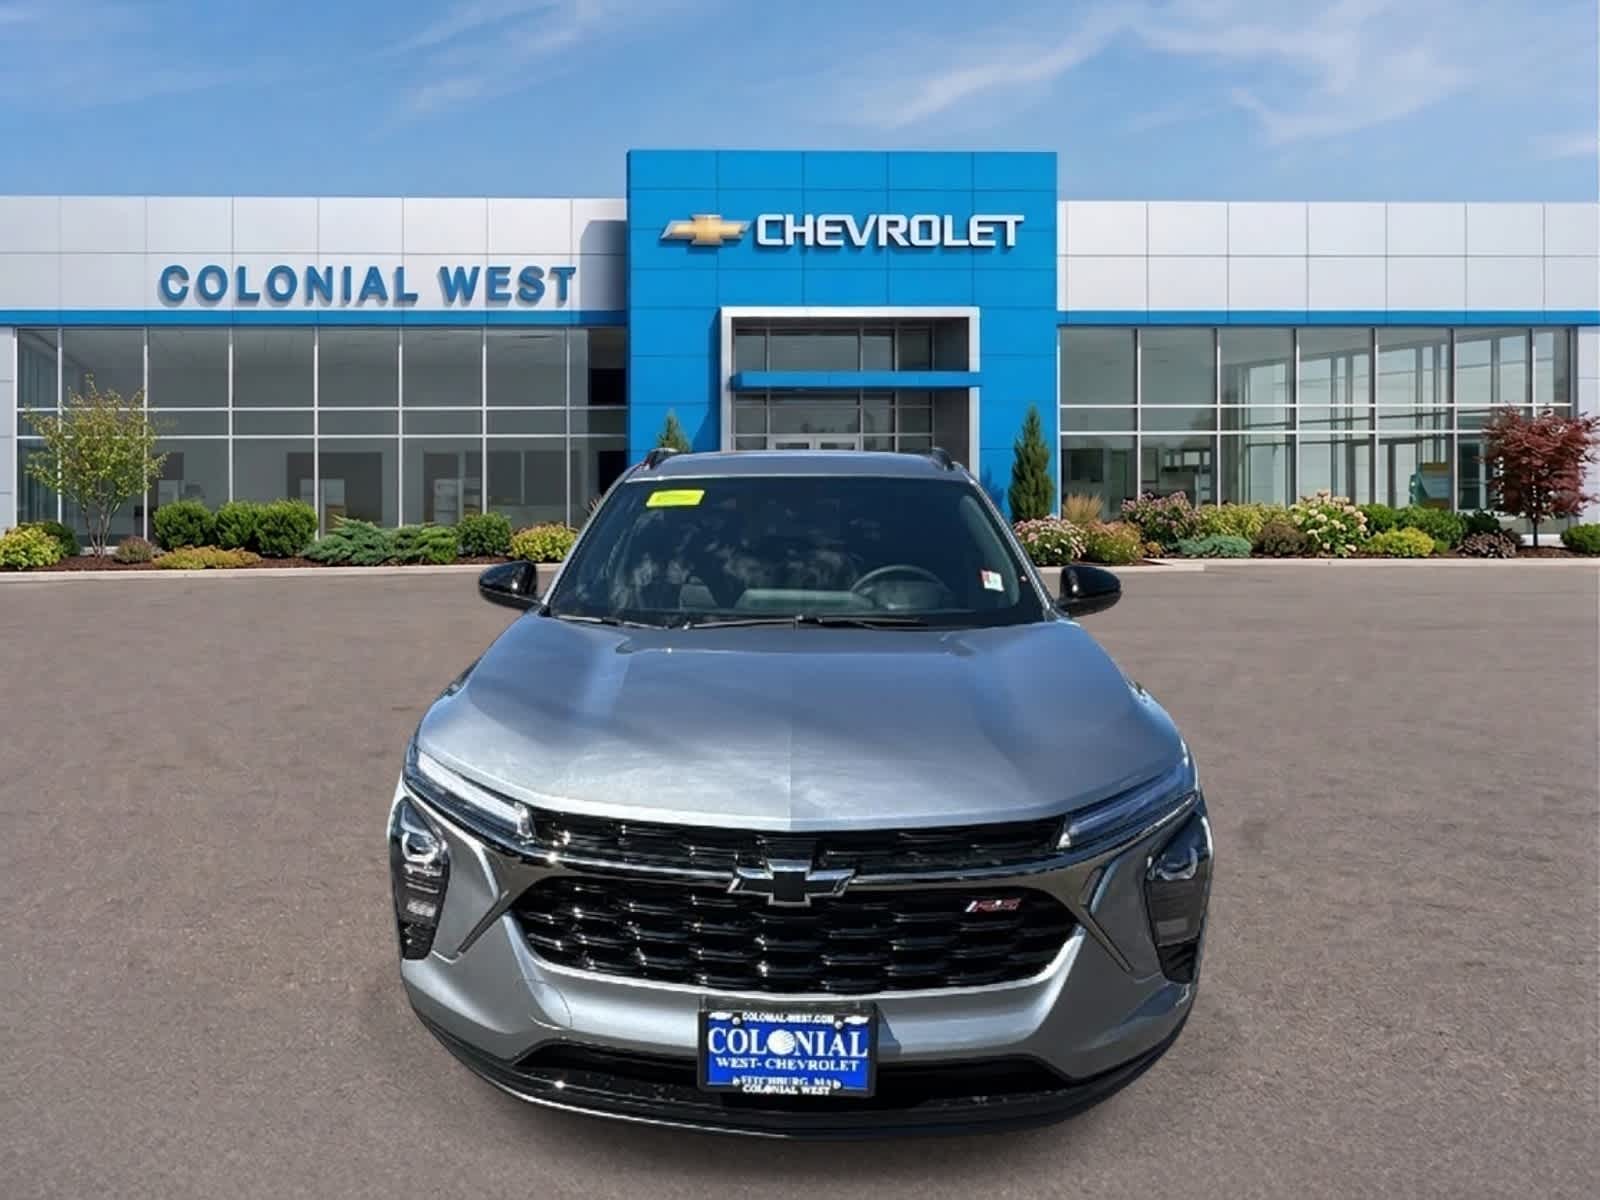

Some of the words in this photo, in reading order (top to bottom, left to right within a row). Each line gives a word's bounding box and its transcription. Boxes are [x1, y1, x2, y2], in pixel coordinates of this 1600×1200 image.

[756, 214, 1025, 247] CHEVROLET
[158, 264, 419, 303] COLONIAL
[437, 265, 577, 303] WEST
[708, 1027, 868, 1057] COLONIAL
[765, 1058, 859, 1072] CHEVROLET
[742, 1085, 798, 1095] COLONIAL
[801, 1086, 829, 1095] WEST
